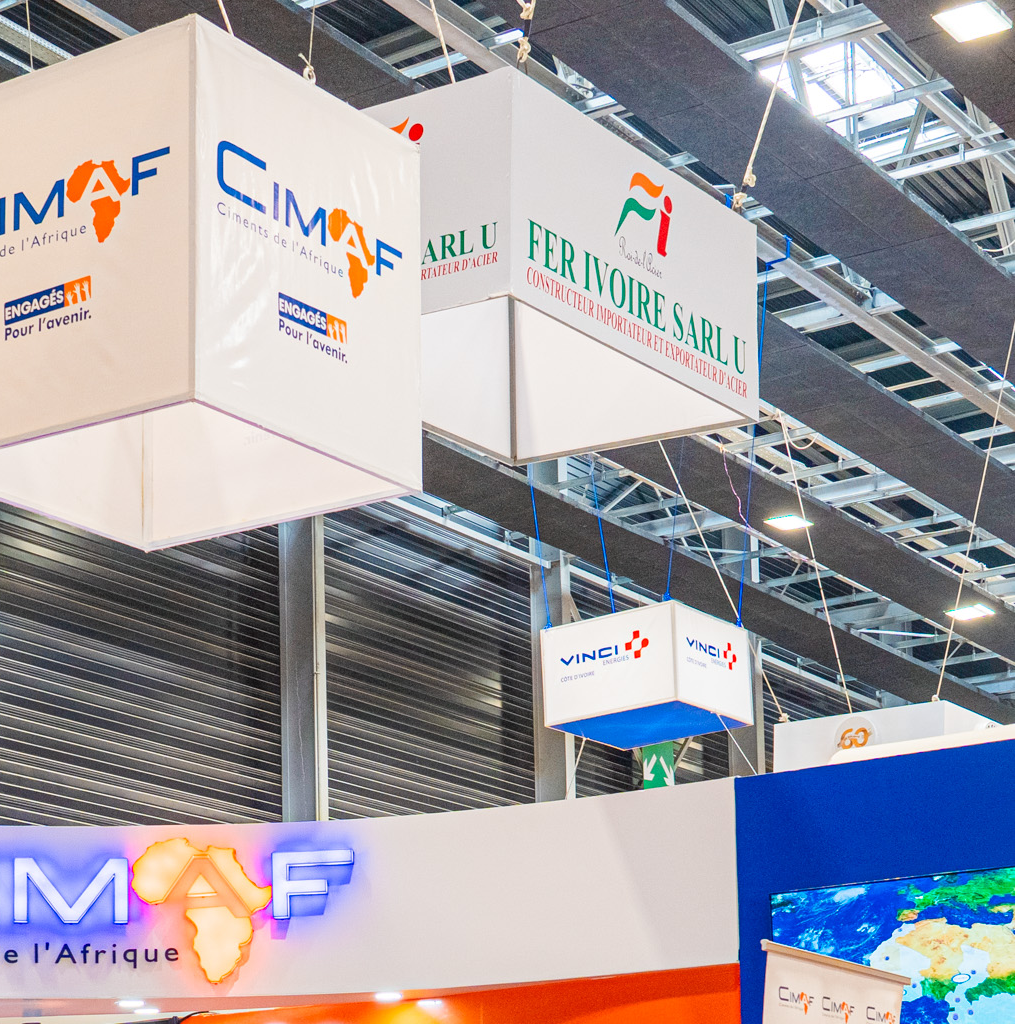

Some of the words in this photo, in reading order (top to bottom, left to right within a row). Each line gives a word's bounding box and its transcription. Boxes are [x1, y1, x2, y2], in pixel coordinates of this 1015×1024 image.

[217, 140, 402, 277] CIMAF
[0, 242, 15, 258] de
[21, 223, 87, 251] l'Afrique
[217, 202, 269, 239] Ciments
[273, 230, 287, 248] de
[291, 239, 344, 280] l'Afrique
[481, 221, 498, 250] U
[461, 251, 498, 271] D'ACIER
[5, 288, 65, 322] ENGAGÉS
[528, 219, 575, 284] FER
[584, 250, 666, 332] IVOIRE
[673, 302, 728, 366] SARL
[733, 335, 747, 375] U
[4, 323, 34, 342] Pour
[38, 306, 92, 333] l'avenir.
[278, 297, 327, 331] ENGAGÉS
[278, 318, 305, 345] Pour
[306, 330, 349, 364] l'avenir.
[526, 266, 594, 318] CONSTRUCTEUR
[596, 303, 652, 348] IMPORTATEUR
[654, 335, 664, 353] ET
[665, 340, 717, 383] EXPORTATEUR
[718, 368, 748, 399] D'ACIER
[560, 644, 619, 666] VINCI
[603, 654, 630, 666] ENERGIES
[686, 637, 720, 658] VINCI
[560, 674, 573, 683] CÔTE
[574, 670, 595, 681] D'IVOIRE
[841, 727, 869, 750] 60
[33, 942, 180, 970] l'Afrique
[779, 987, 814, 1004] CIMAF
[822, 997, 854, 1014] CIMAF
